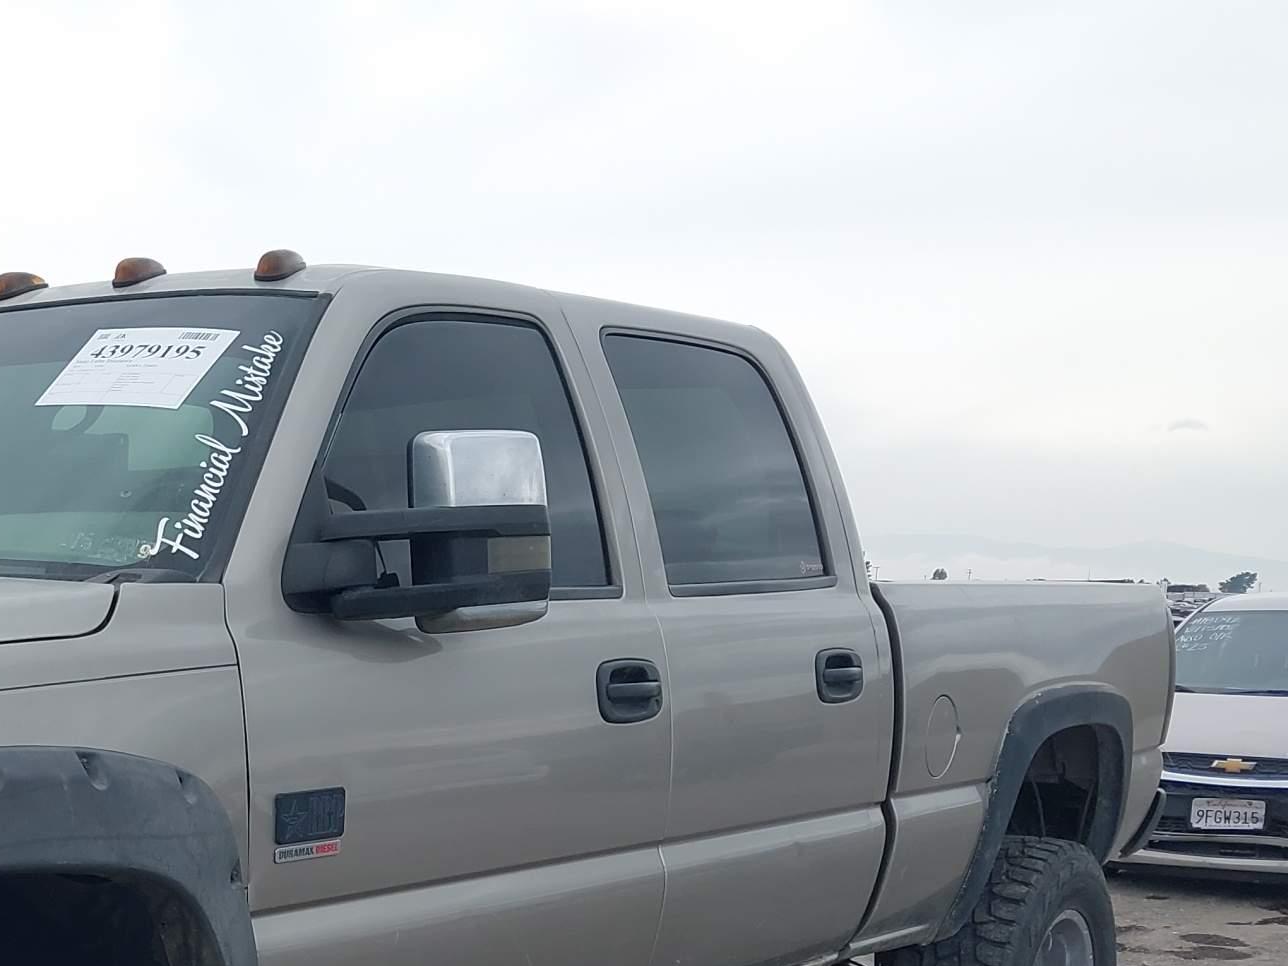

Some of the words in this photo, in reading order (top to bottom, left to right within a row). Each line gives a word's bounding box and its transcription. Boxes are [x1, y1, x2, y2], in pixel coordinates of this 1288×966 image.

[90, 344, 207, 360] 43979195
[137, 433, 242, 560] Financial
[209, 330, 284, 437] Mistake
[1196, 809, 1260, 825] 9FGW315
[279, 847, 314, 860] DURAMAX
[315, 842, 338, 855] DIESEL
